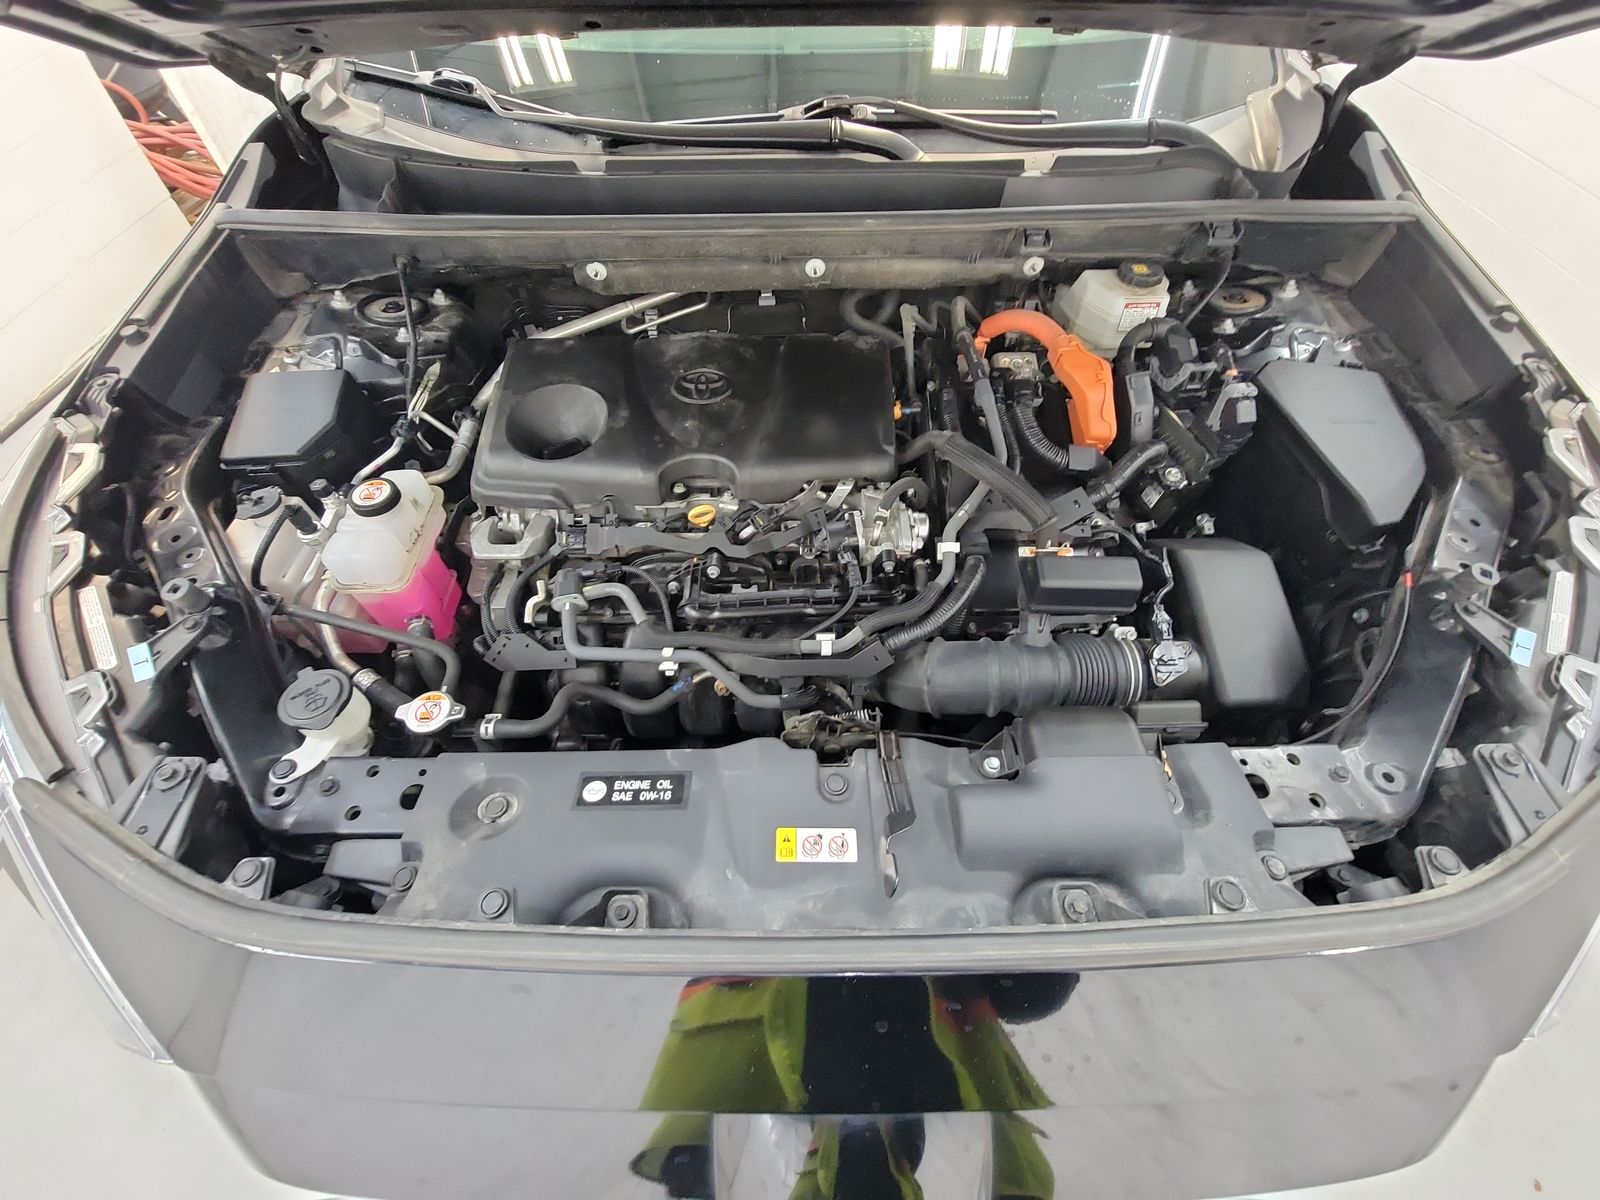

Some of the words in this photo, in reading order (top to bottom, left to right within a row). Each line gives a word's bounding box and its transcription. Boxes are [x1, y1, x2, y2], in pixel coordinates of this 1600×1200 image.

[614, 780, 651, 790] ENGINE
[656, 780, 673, 789] OIL
[611, 791, 633, 801] SAE
[639, 791, 672, 801] 0W-16
